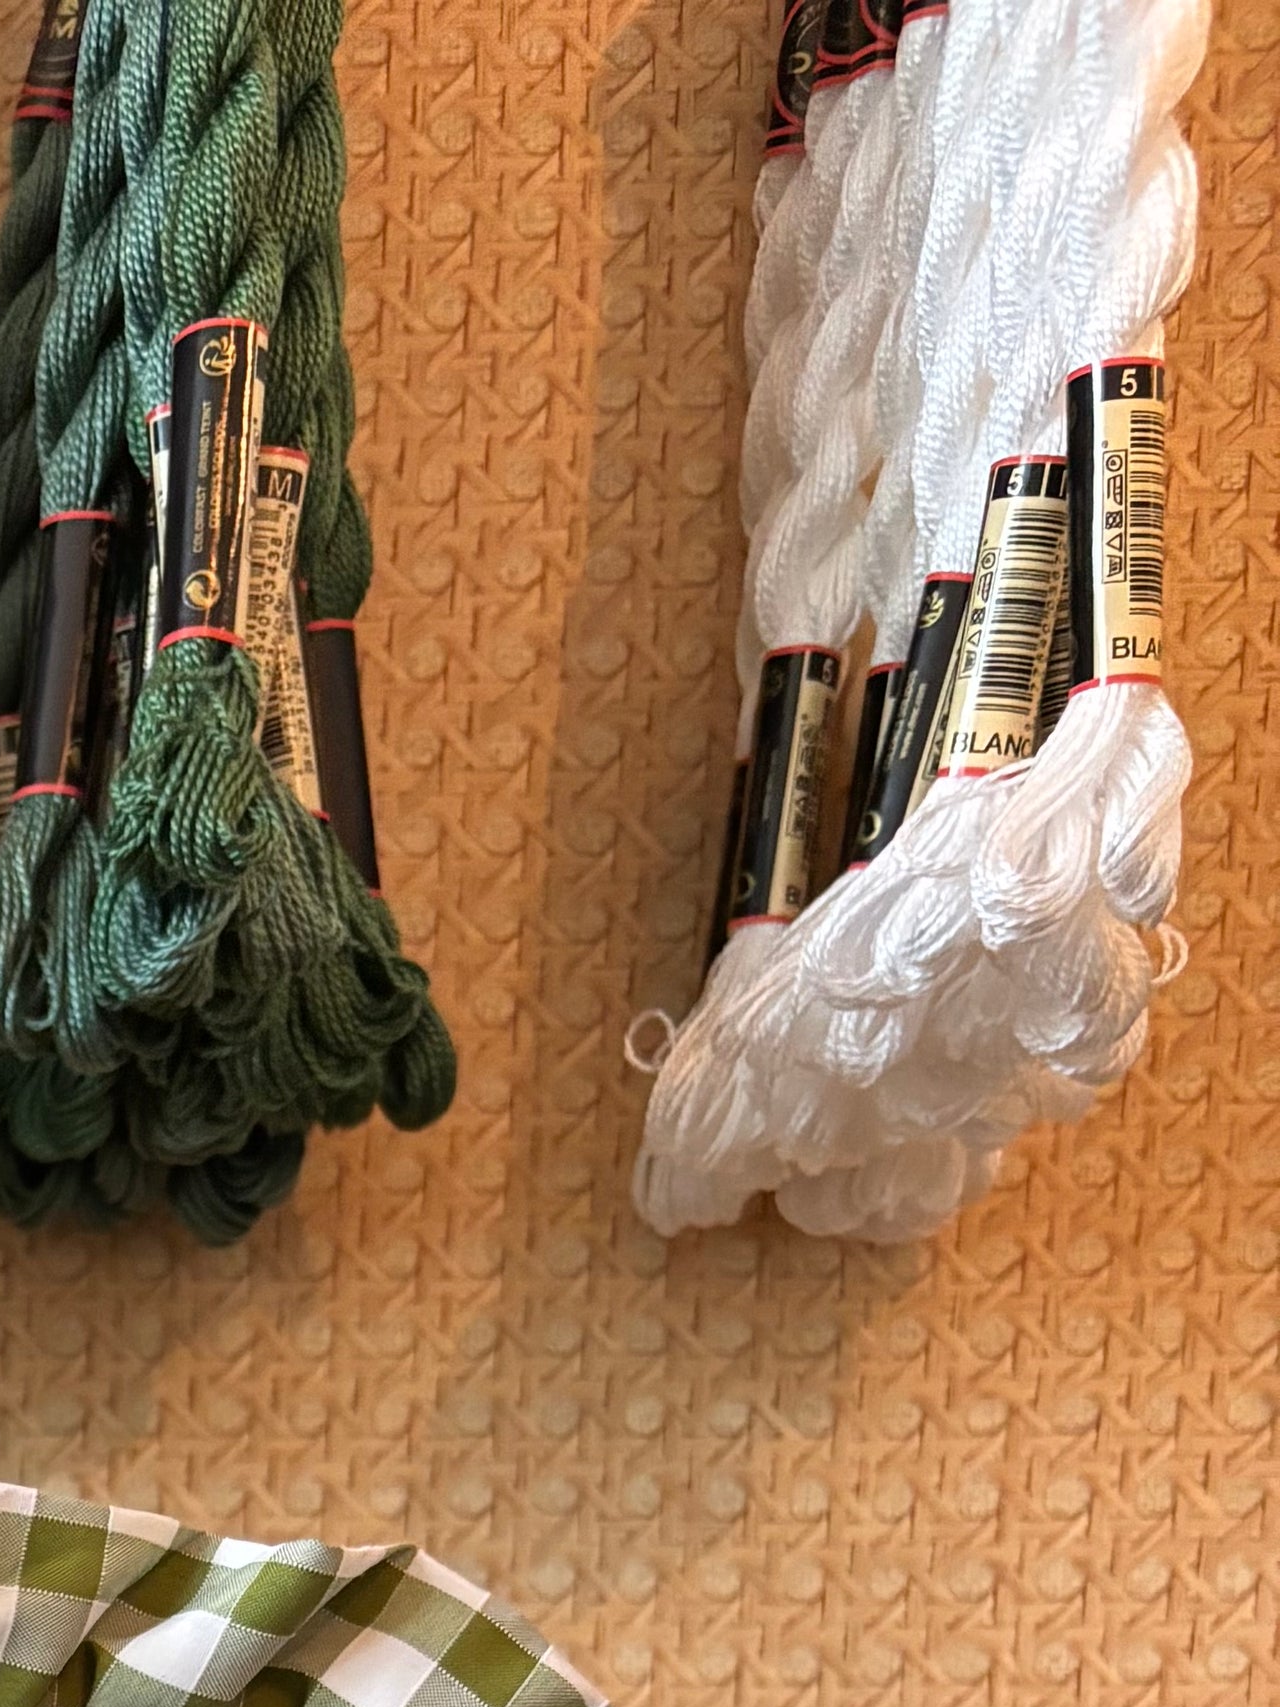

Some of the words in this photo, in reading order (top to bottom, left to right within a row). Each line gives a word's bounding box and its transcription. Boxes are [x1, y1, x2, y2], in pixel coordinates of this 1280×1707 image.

[1120, 368, 1138, 396] 5
[268, 470, 292, 500] M
[1006, 467, 1023, 496] 5
[1111, 636, 1162, 660] BLA
